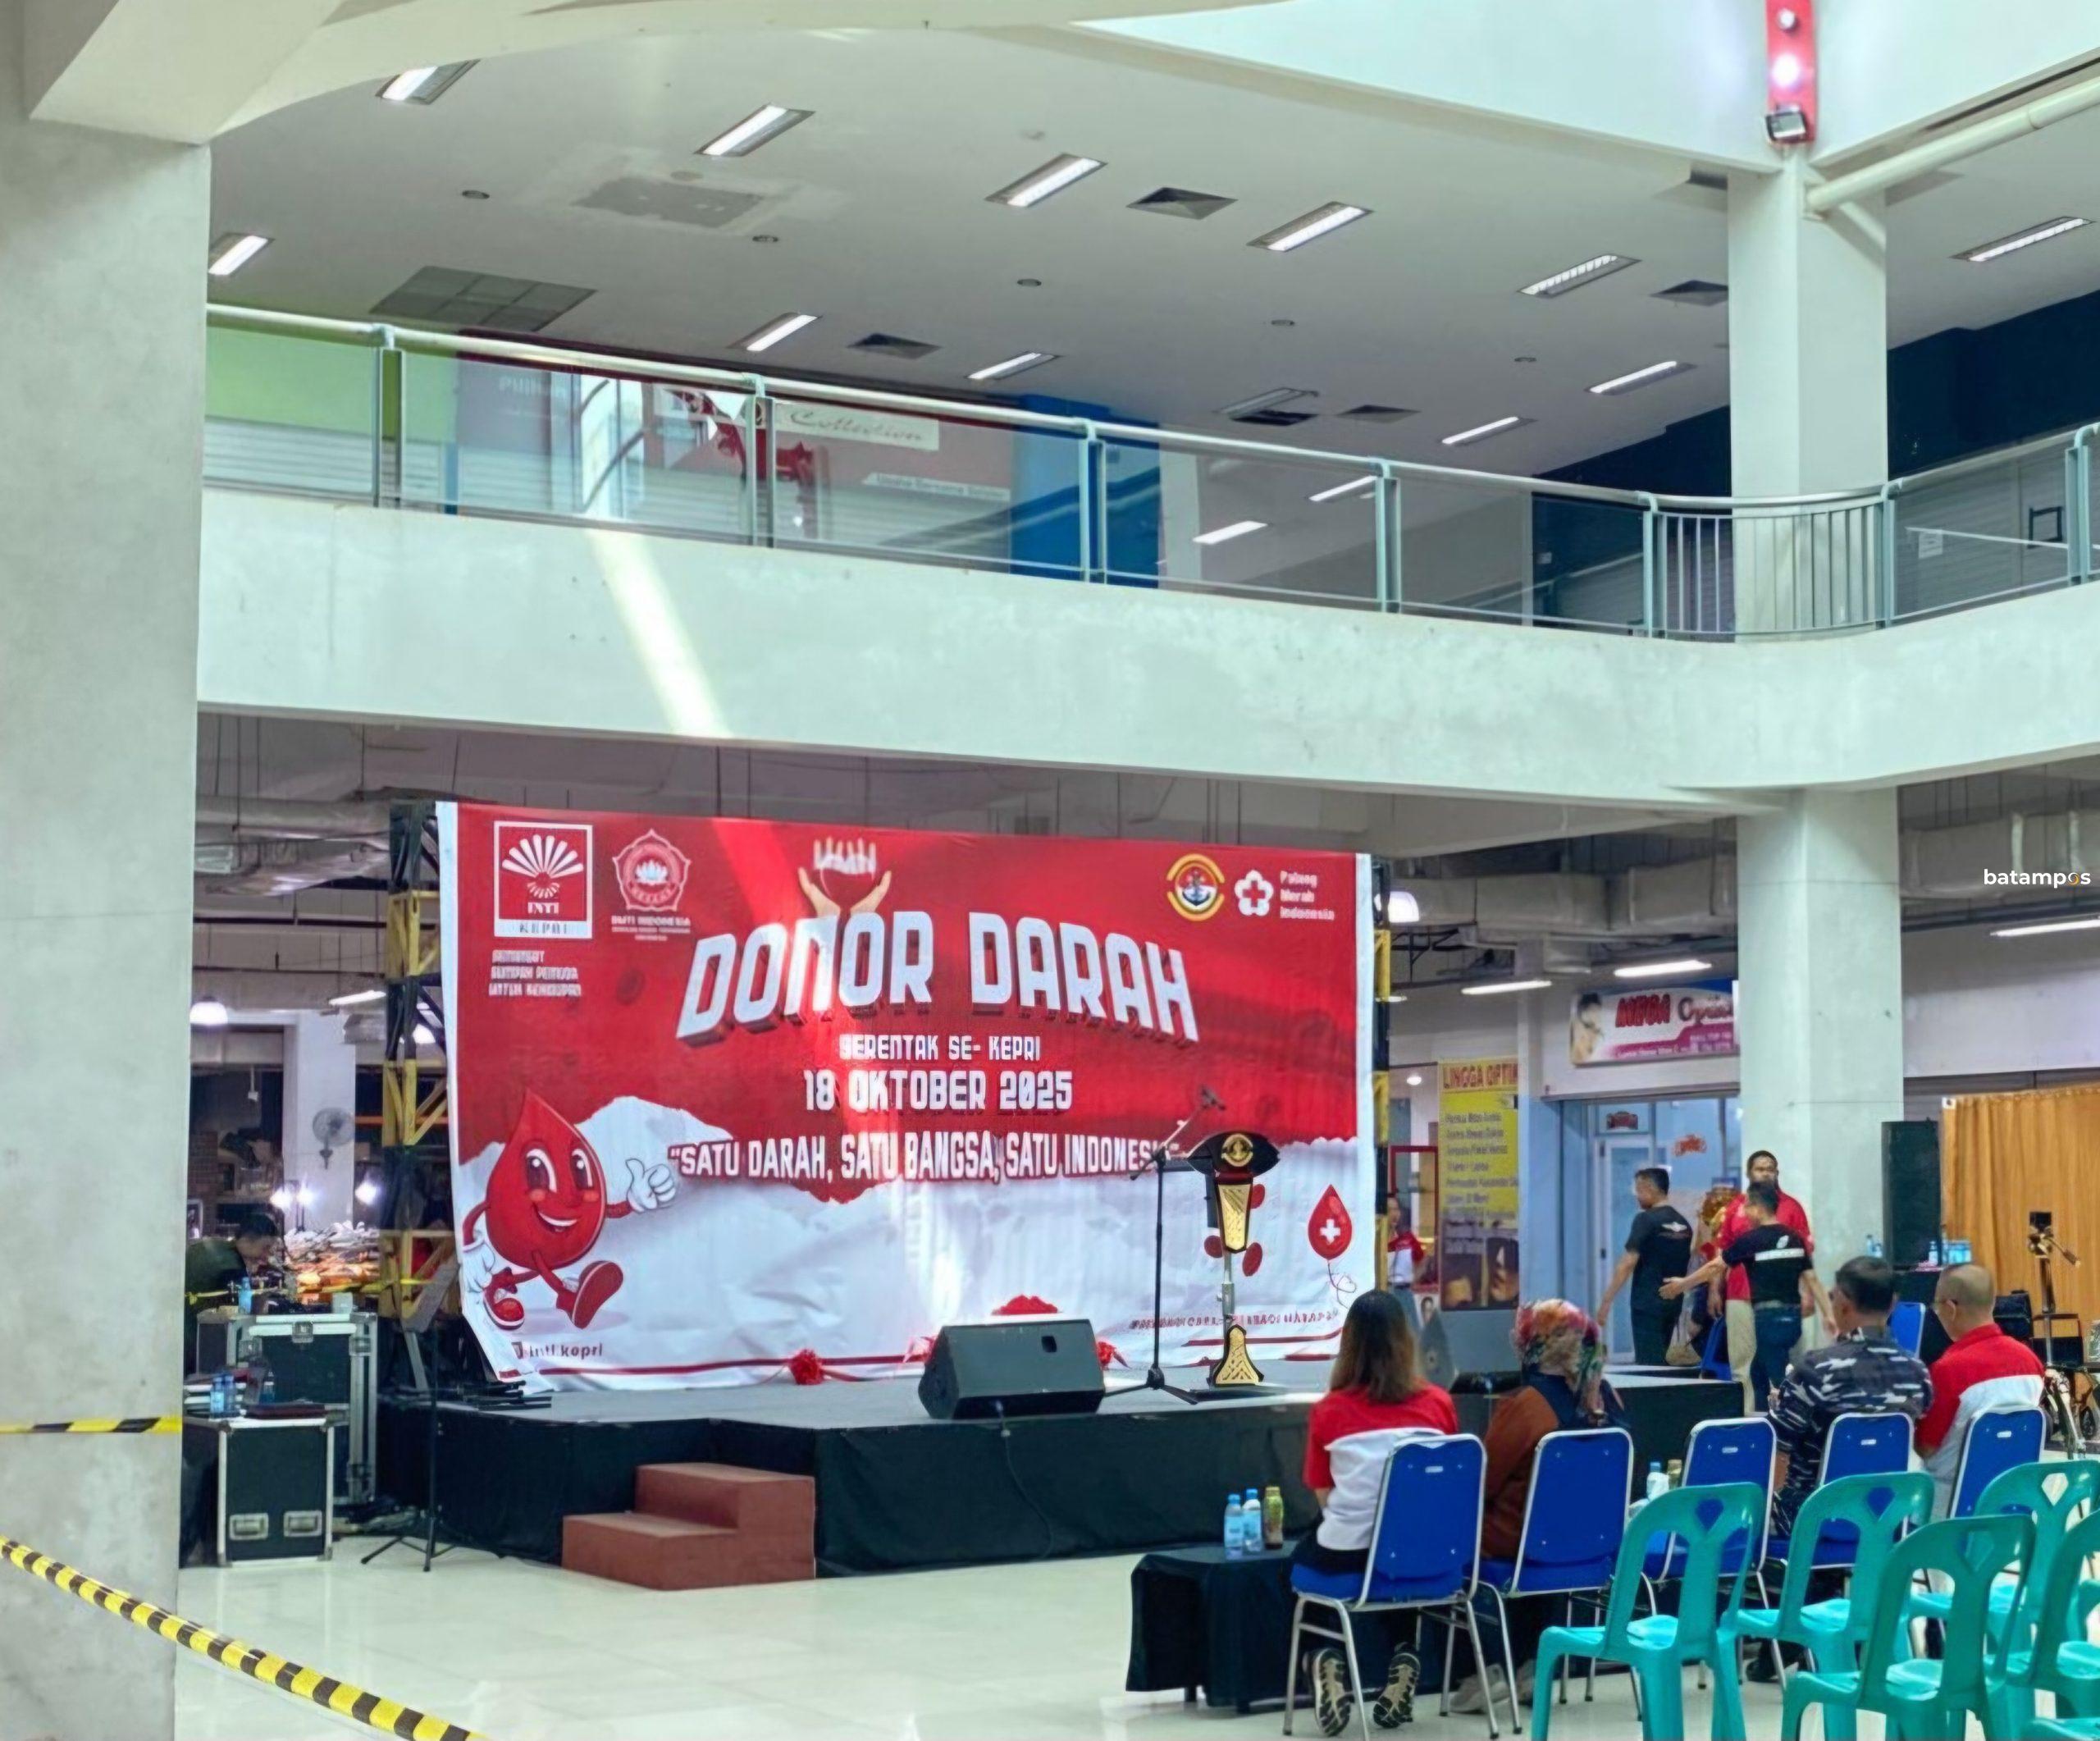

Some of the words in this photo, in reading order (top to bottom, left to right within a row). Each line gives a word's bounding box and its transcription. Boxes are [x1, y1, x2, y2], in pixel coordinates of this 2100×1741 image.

[1280, 906, 1335, 921] Indonesia
[676, 911, 934, 1042] DONOR
[969, 912, 1198, 1044] DARAH
[839, 1034, 939, 1060] SERENTAK
[988, 1035, 1041, 1062] KEPRI
[803, 1068, 836, 1111] 18
[847, 1069, 987, 1113] OKTOBER
[999, 1070, 1074, 1111] 2025
[748, 1136, 833, 1183] DARAH,
[841, 1132, 898, 1179] SATU
[1006, 1131, 1058, 1178] SATU
